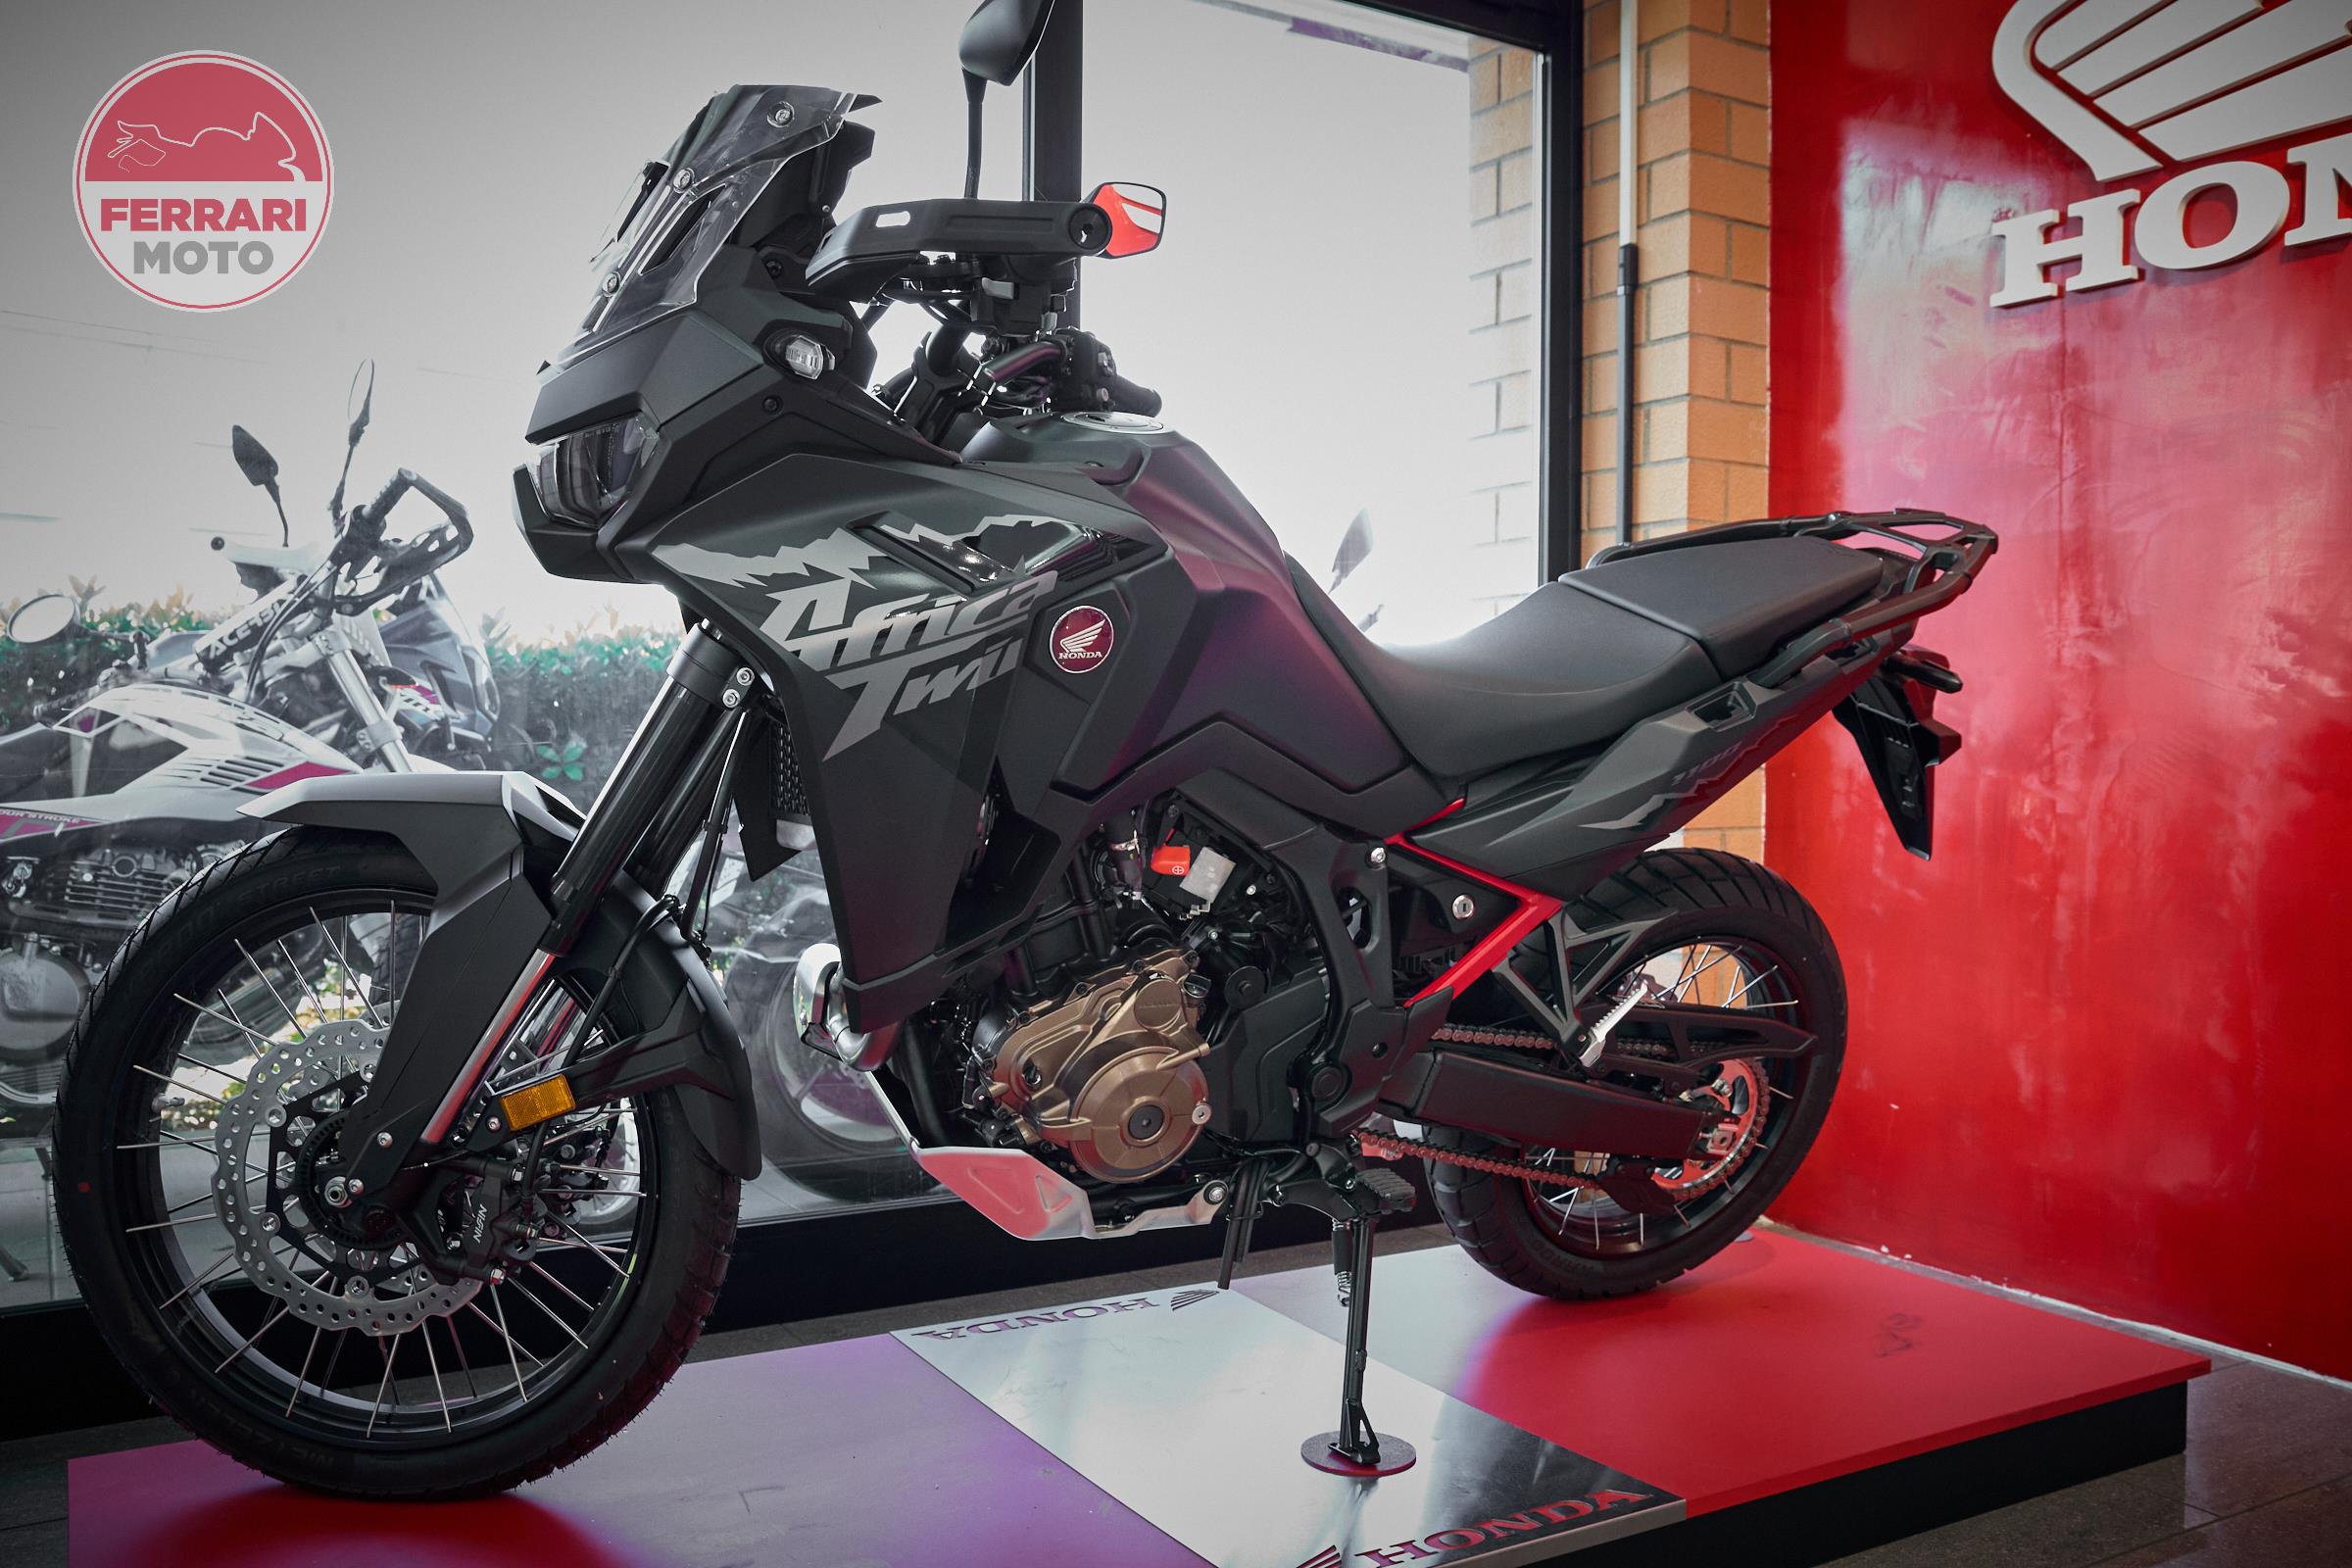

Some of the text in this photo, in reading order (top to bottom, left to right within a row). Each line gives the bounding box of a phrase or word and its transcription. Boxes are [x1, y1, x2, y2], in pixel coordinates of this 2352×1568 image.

[760, 570, 1058, 672] Africa
[1058, 651, 1103, 660] HONDA
[912, 1298, 1160, 1341] HONDA
[1354, 1489, 1655, 1568] HONDA
